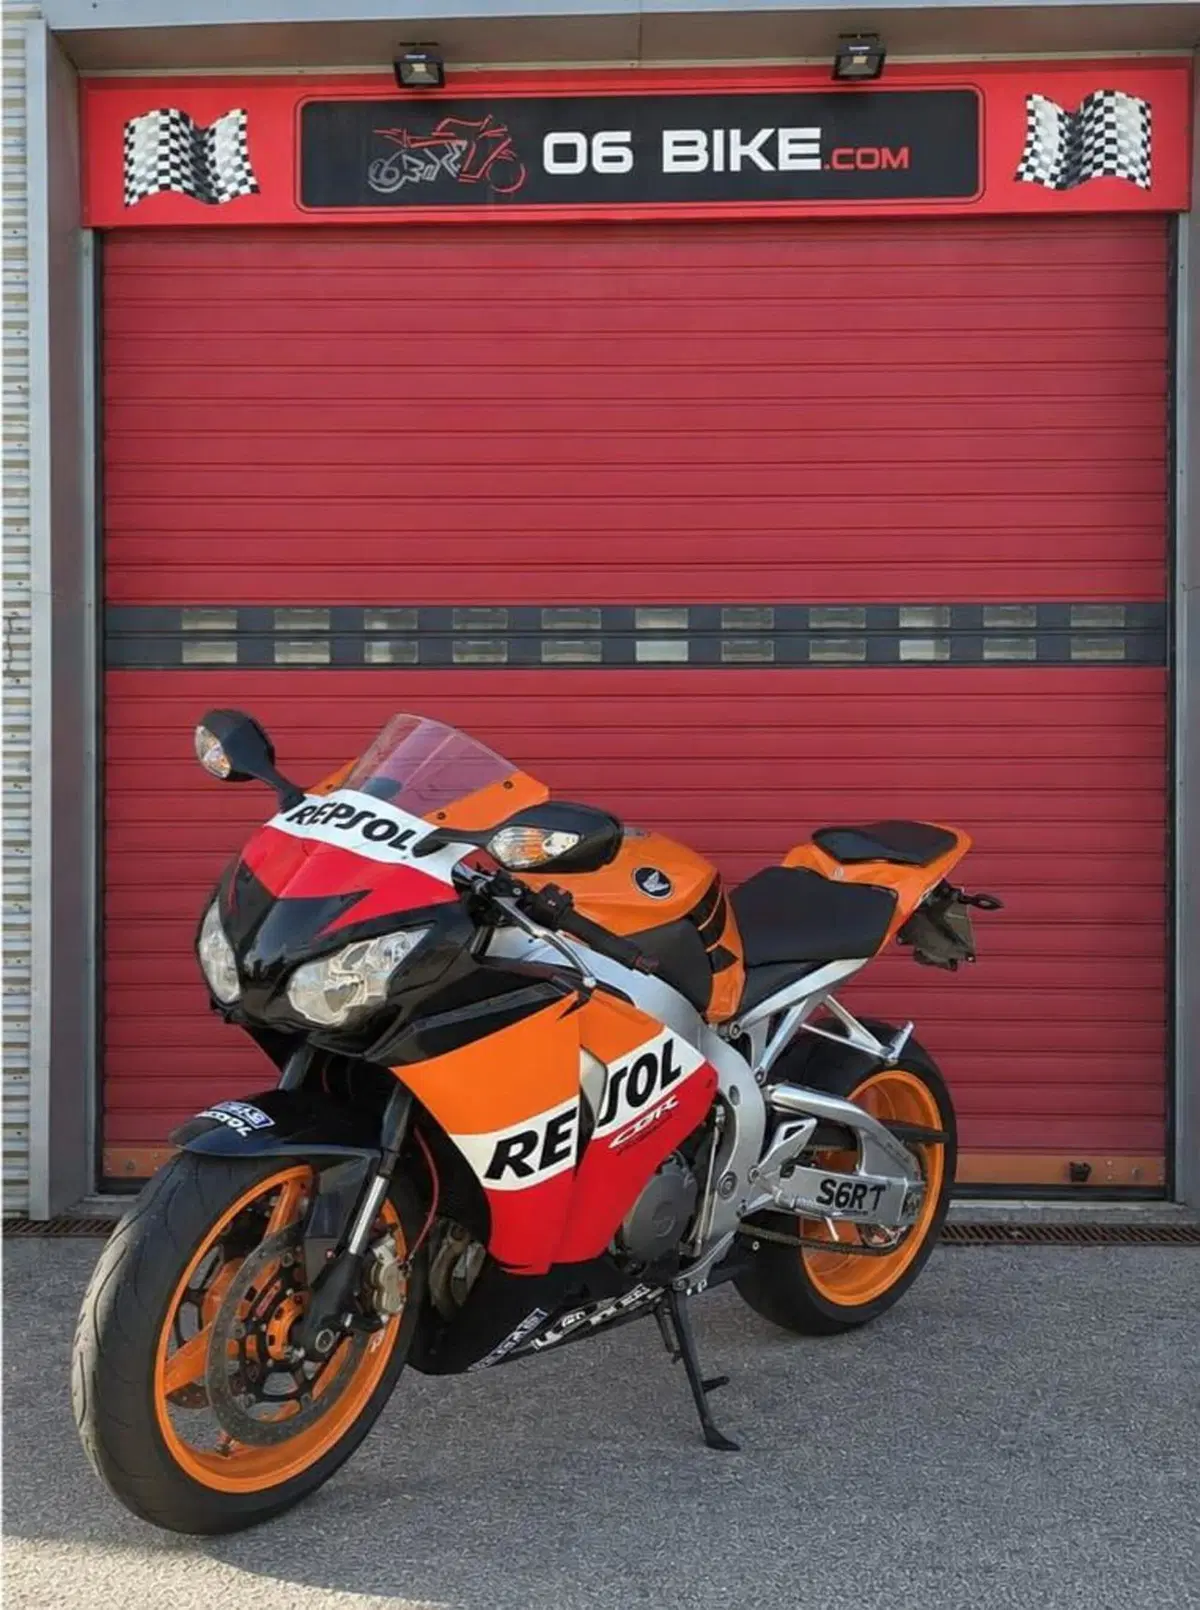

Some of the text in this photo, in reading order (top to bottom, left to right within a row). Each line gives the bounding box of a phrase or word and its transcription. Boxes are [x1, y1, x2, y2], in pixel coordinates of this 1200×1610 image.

[543, 131, 633, 174] 06
[286, 802, 417, 850] REPSOL
[484, 1038, 682, 1180] RESOL
